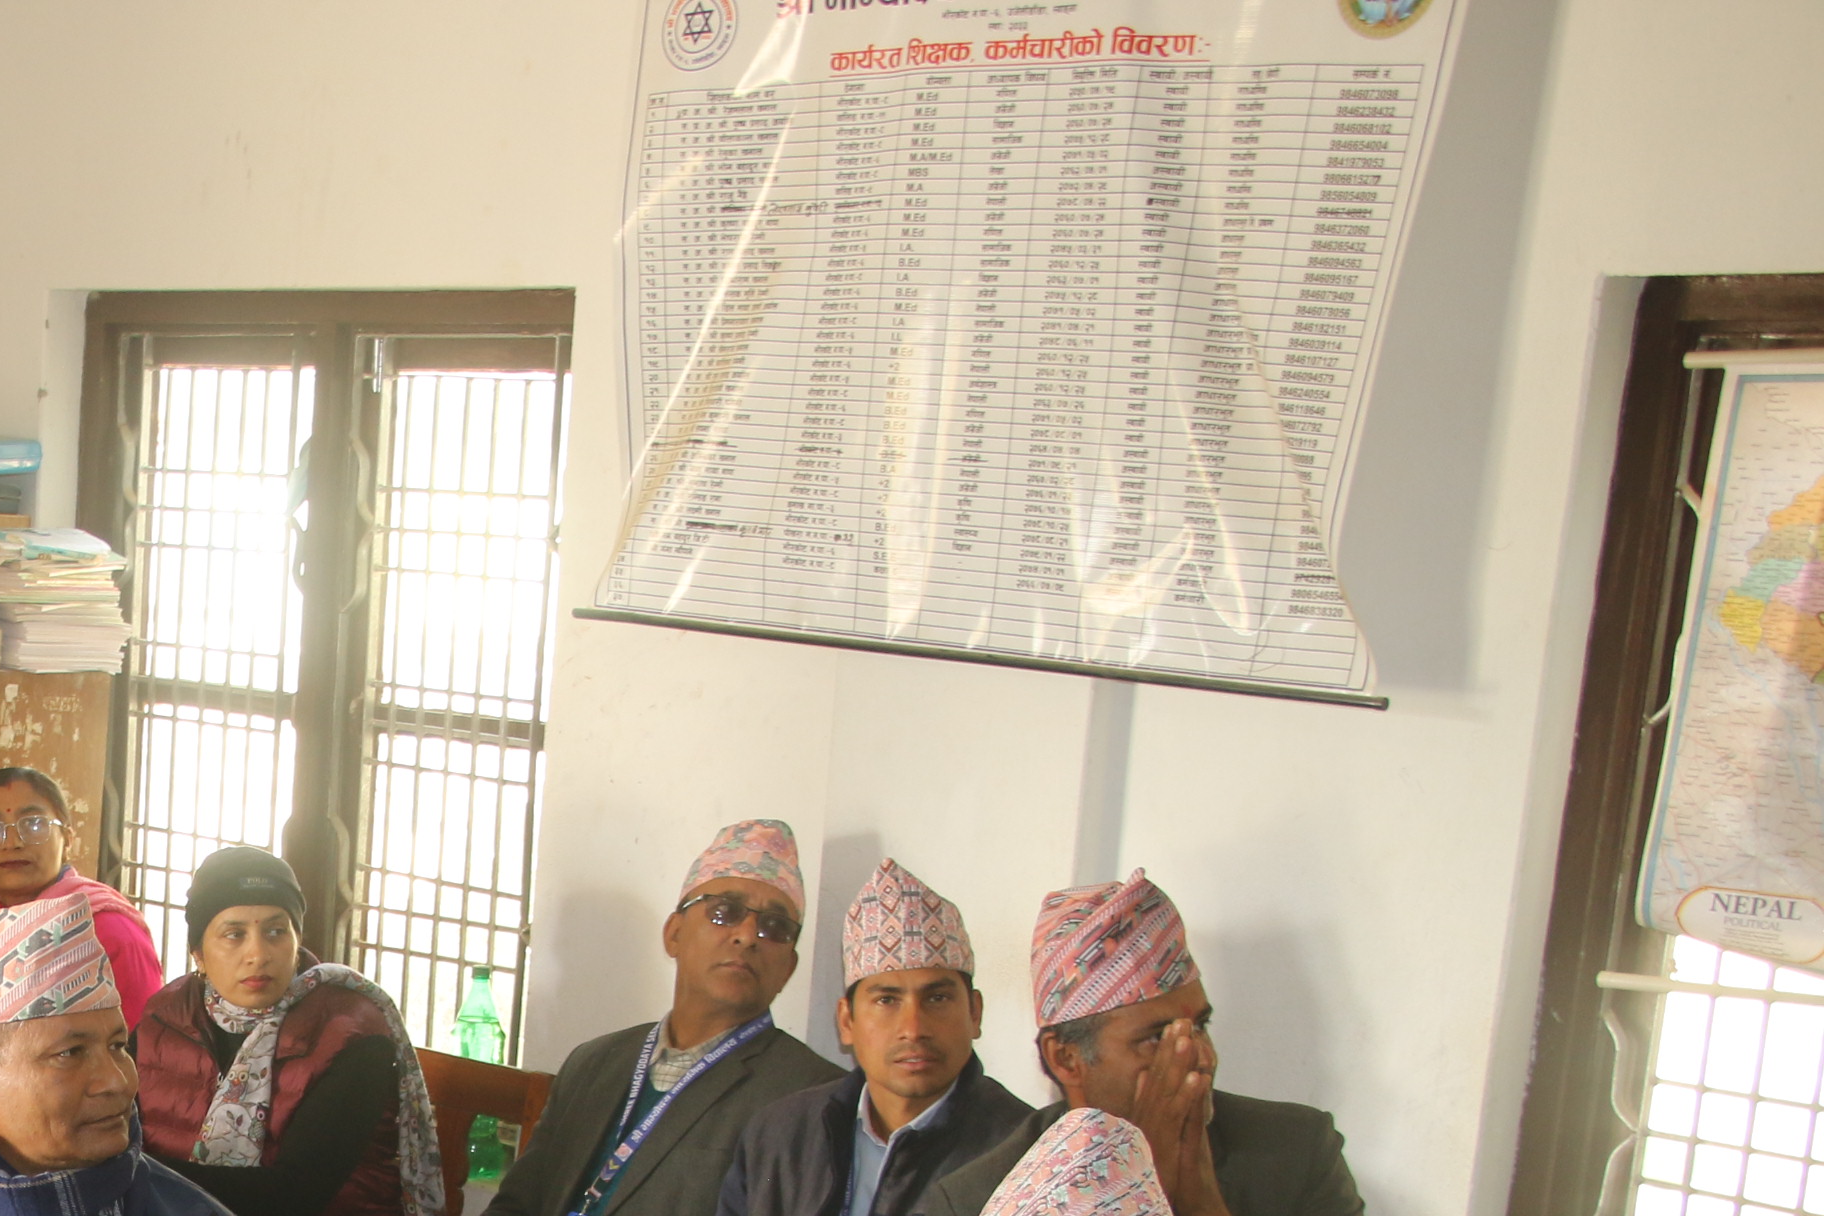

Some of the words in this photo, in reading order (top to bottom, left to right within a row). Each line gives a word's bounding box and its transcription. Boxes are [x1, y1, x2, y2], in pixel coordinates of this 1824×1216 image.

[830, 45, 903, 71] कार्यरत
[984, 29, 1103, 59] कर्मचारीको
[908, 168, 928, 176] MBS
[1709, 892, 1802, 921] NEPAL
[1723, 916, 1783, 931] POLITICAL
[630, 1042, 654, 1099] BHAGYODAYA
